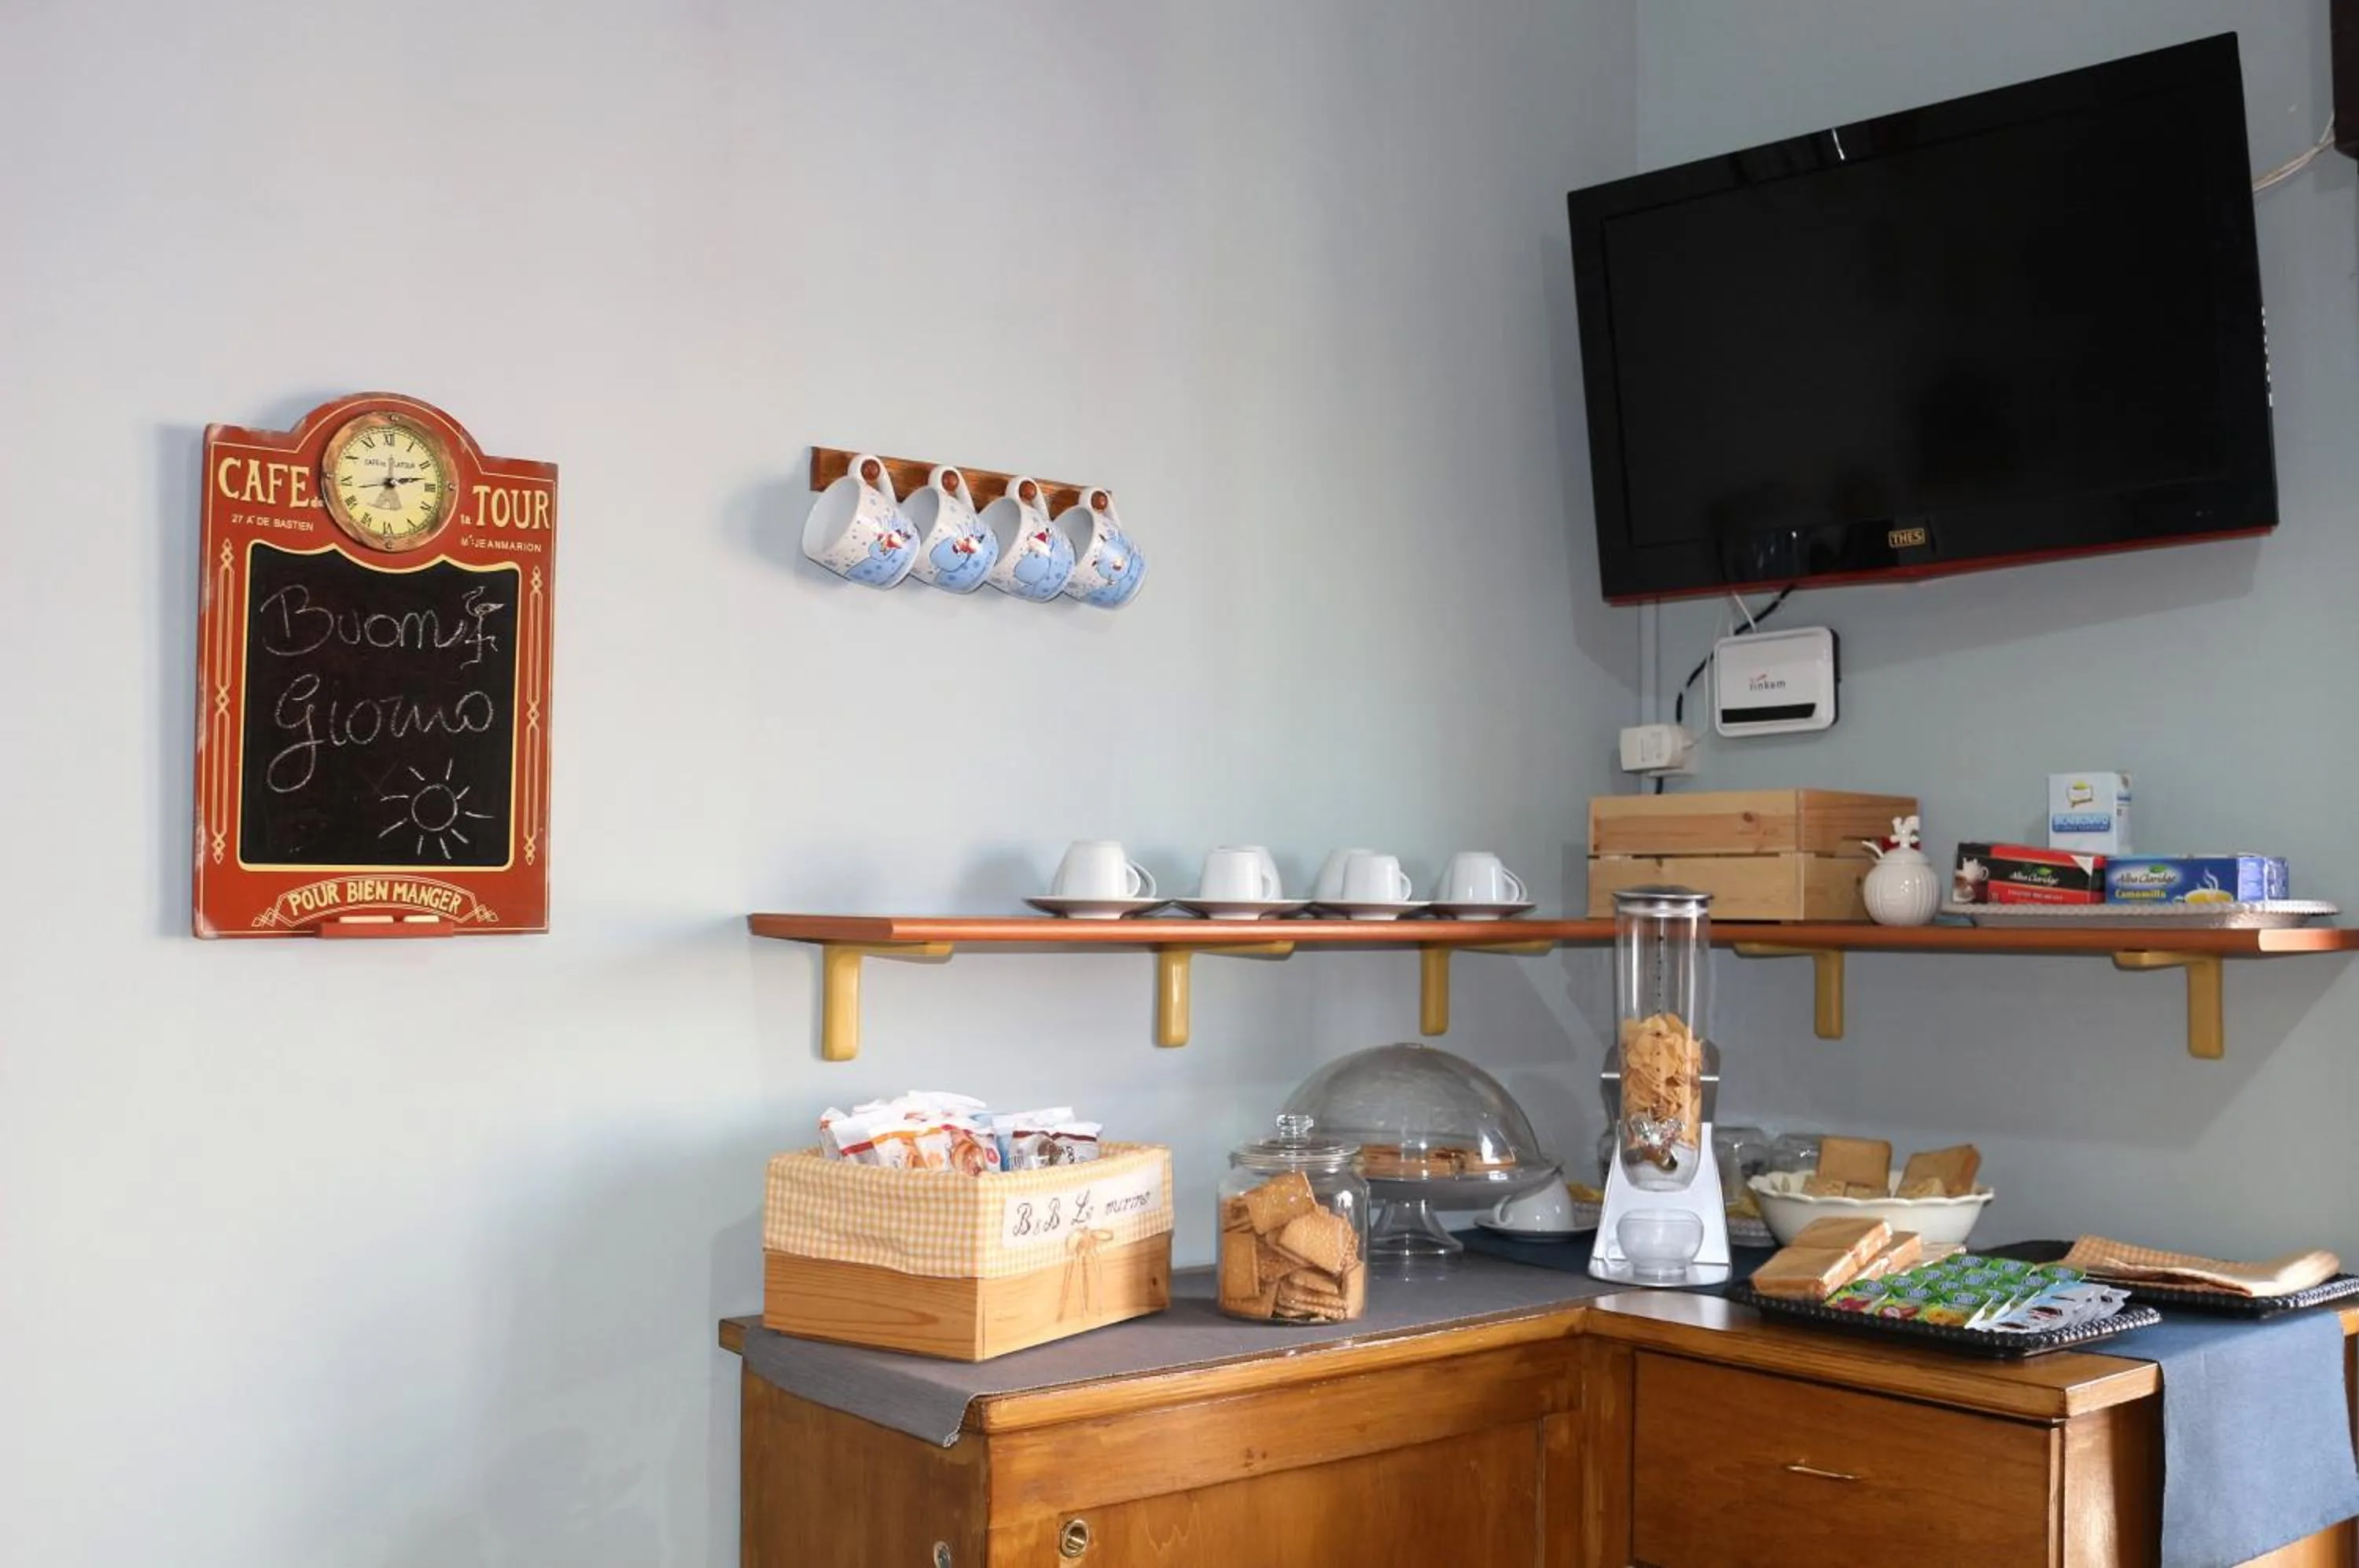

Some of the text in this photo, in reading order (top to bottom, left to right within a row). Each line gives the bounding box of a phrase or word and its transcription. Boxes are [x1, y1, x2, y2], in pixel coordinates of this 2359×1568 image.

[218, 457, 309, 508] CAFE
[472, 484, 550, 529] TOUR
[256, 516, 270, 526] DE
[273, 518, 315, 532] BASTIEN
[287, 880, 462, 915] POUR BIEN MANGER
